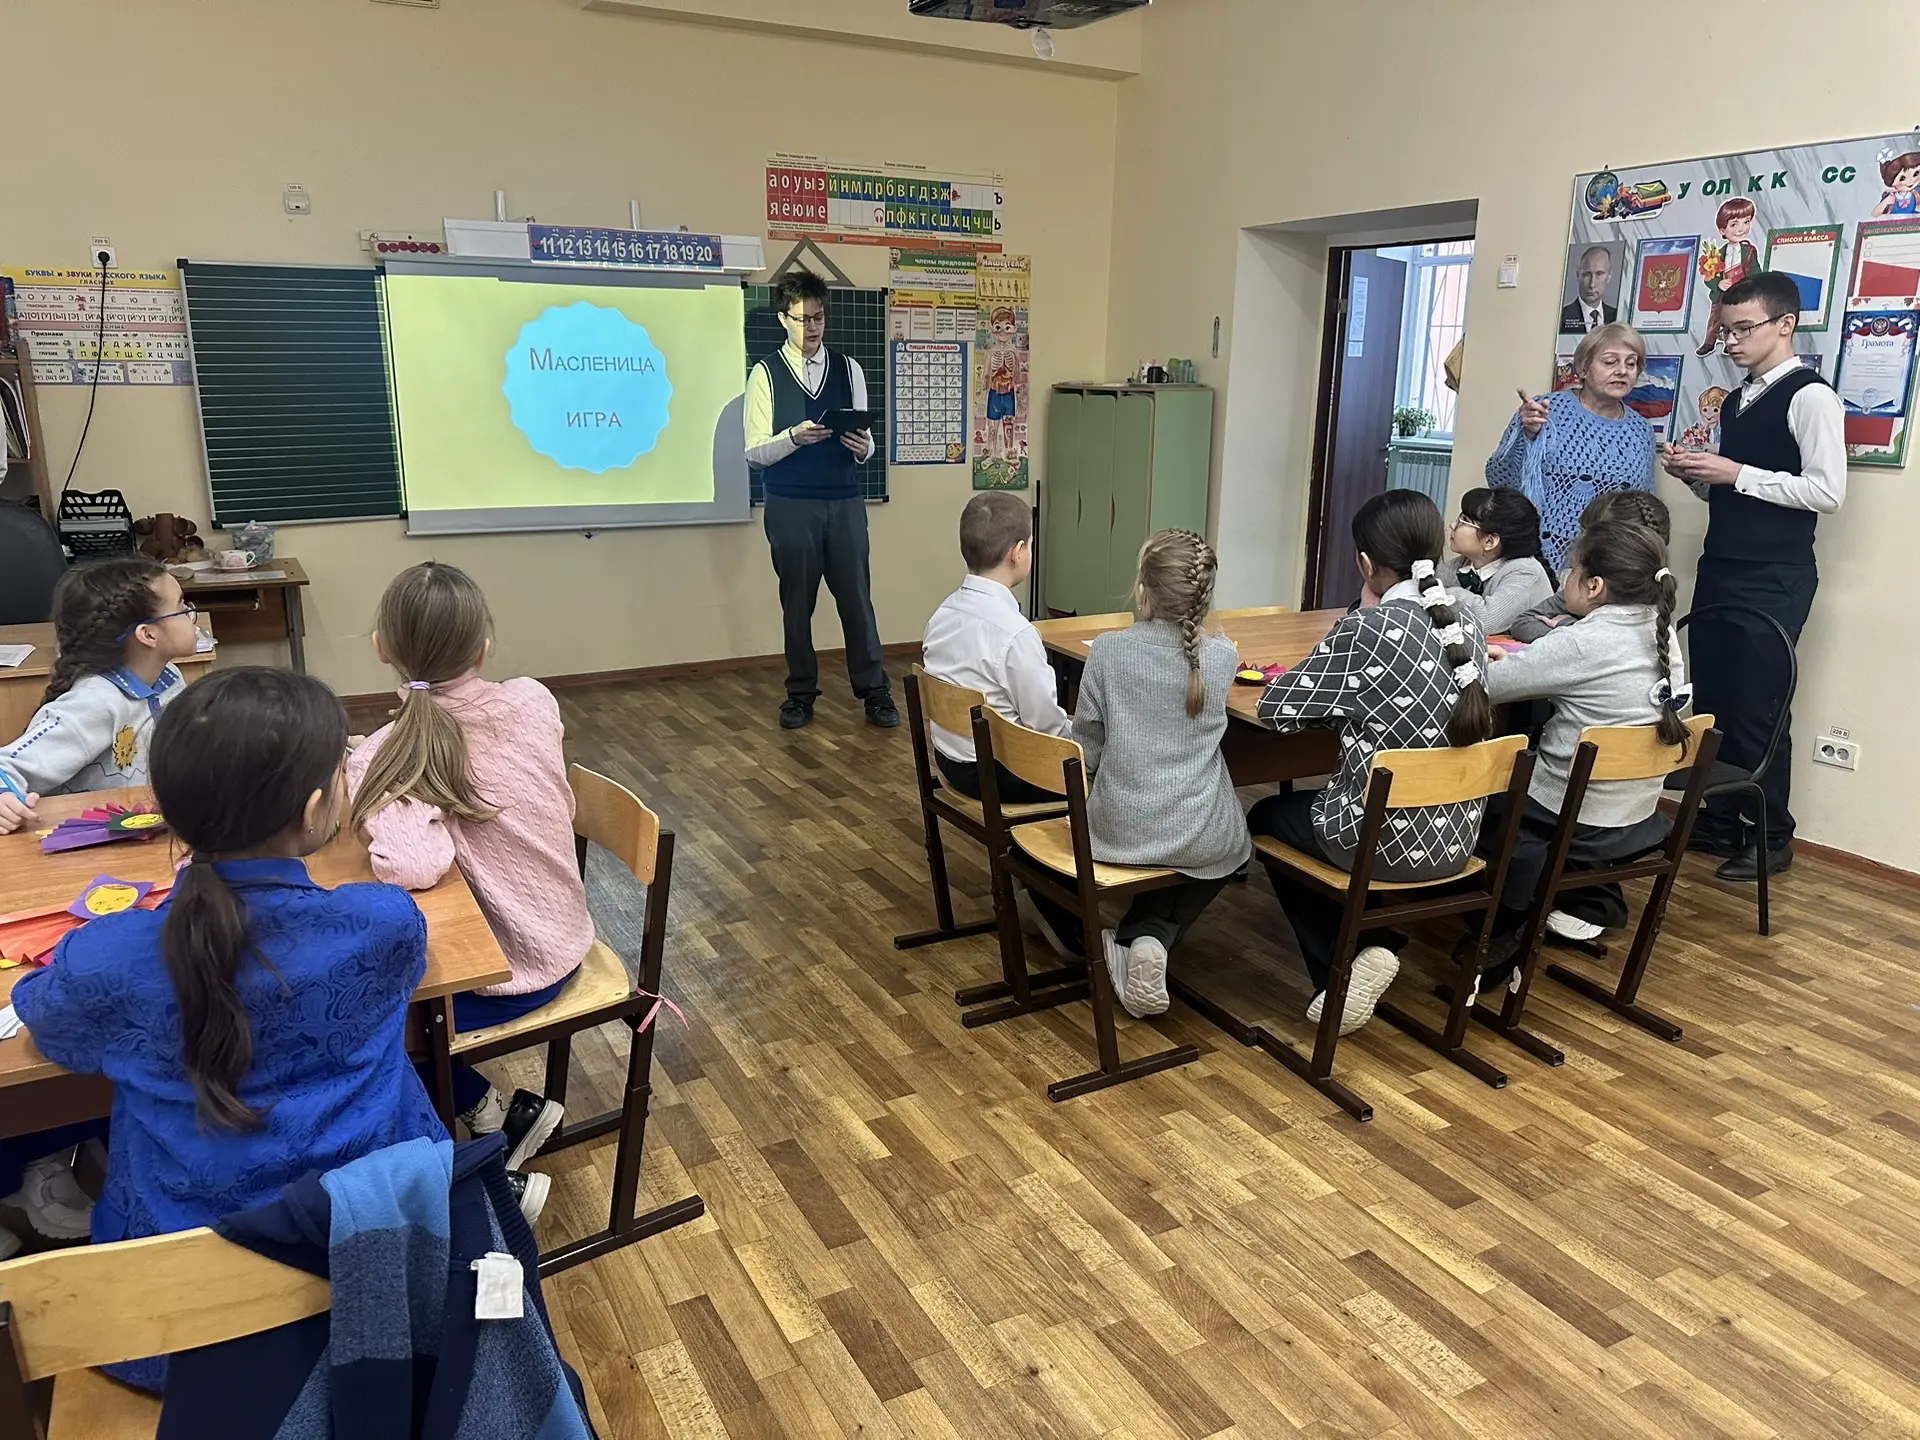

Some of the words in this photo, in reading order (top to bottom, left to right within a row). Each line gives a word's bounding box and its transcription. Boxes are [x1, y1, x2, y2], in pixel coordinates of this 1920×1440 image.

[1776, 236, 1803, 244] СПИСОК
[1804, 234, 1830, 242] КЛАССА
[540, 237, 555, 254] 11
[557, 237, 574, 255] 12
[576, 238, 592, 256] 13
[594, 239, 610, 257] 14
[612, 241, 627, 258] 15
[628, 242, 644, 259] 16
[646, 243, 661, 260] 17
[663, 243, 679, 260] 18
[680, 245, 694, 261] 19
[696, 246, 712, 262] 20
[25, 269, 55, 277] БУКВЫ
[139, 273, 167, 281] ЯЗЫКА
[1861, 339, 1894, 349] Грамота
[566, 411, 622, 428] ИГРА
